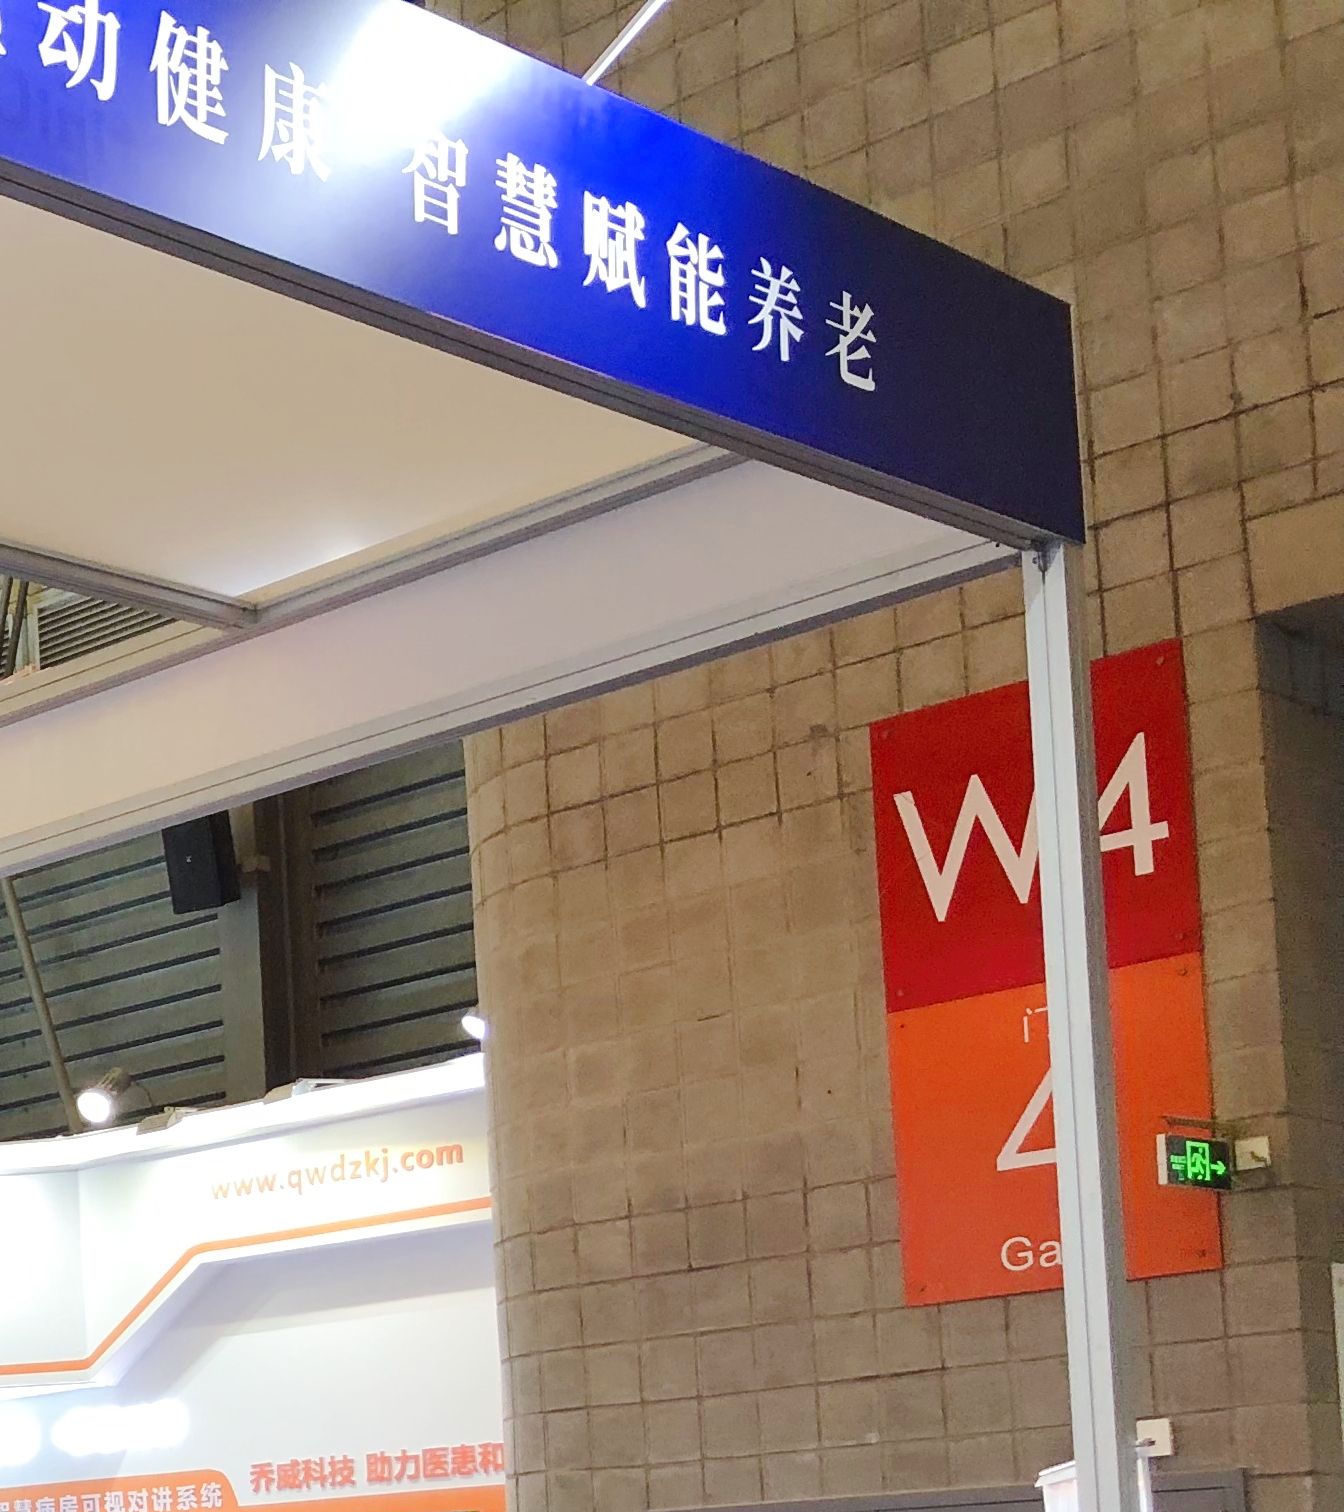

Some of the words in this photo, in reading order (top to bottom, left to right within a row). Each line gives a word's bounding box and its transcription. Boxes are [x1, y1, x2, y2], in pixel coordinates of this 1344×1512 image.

[400, 132, 877, 393] 智慧赋能养老
[893, 730, 1169, 923] W4
[210, 1140, 465, 1200] www.qwdzkj.com
[249, 1456, 356, 1496] 乔威科技
